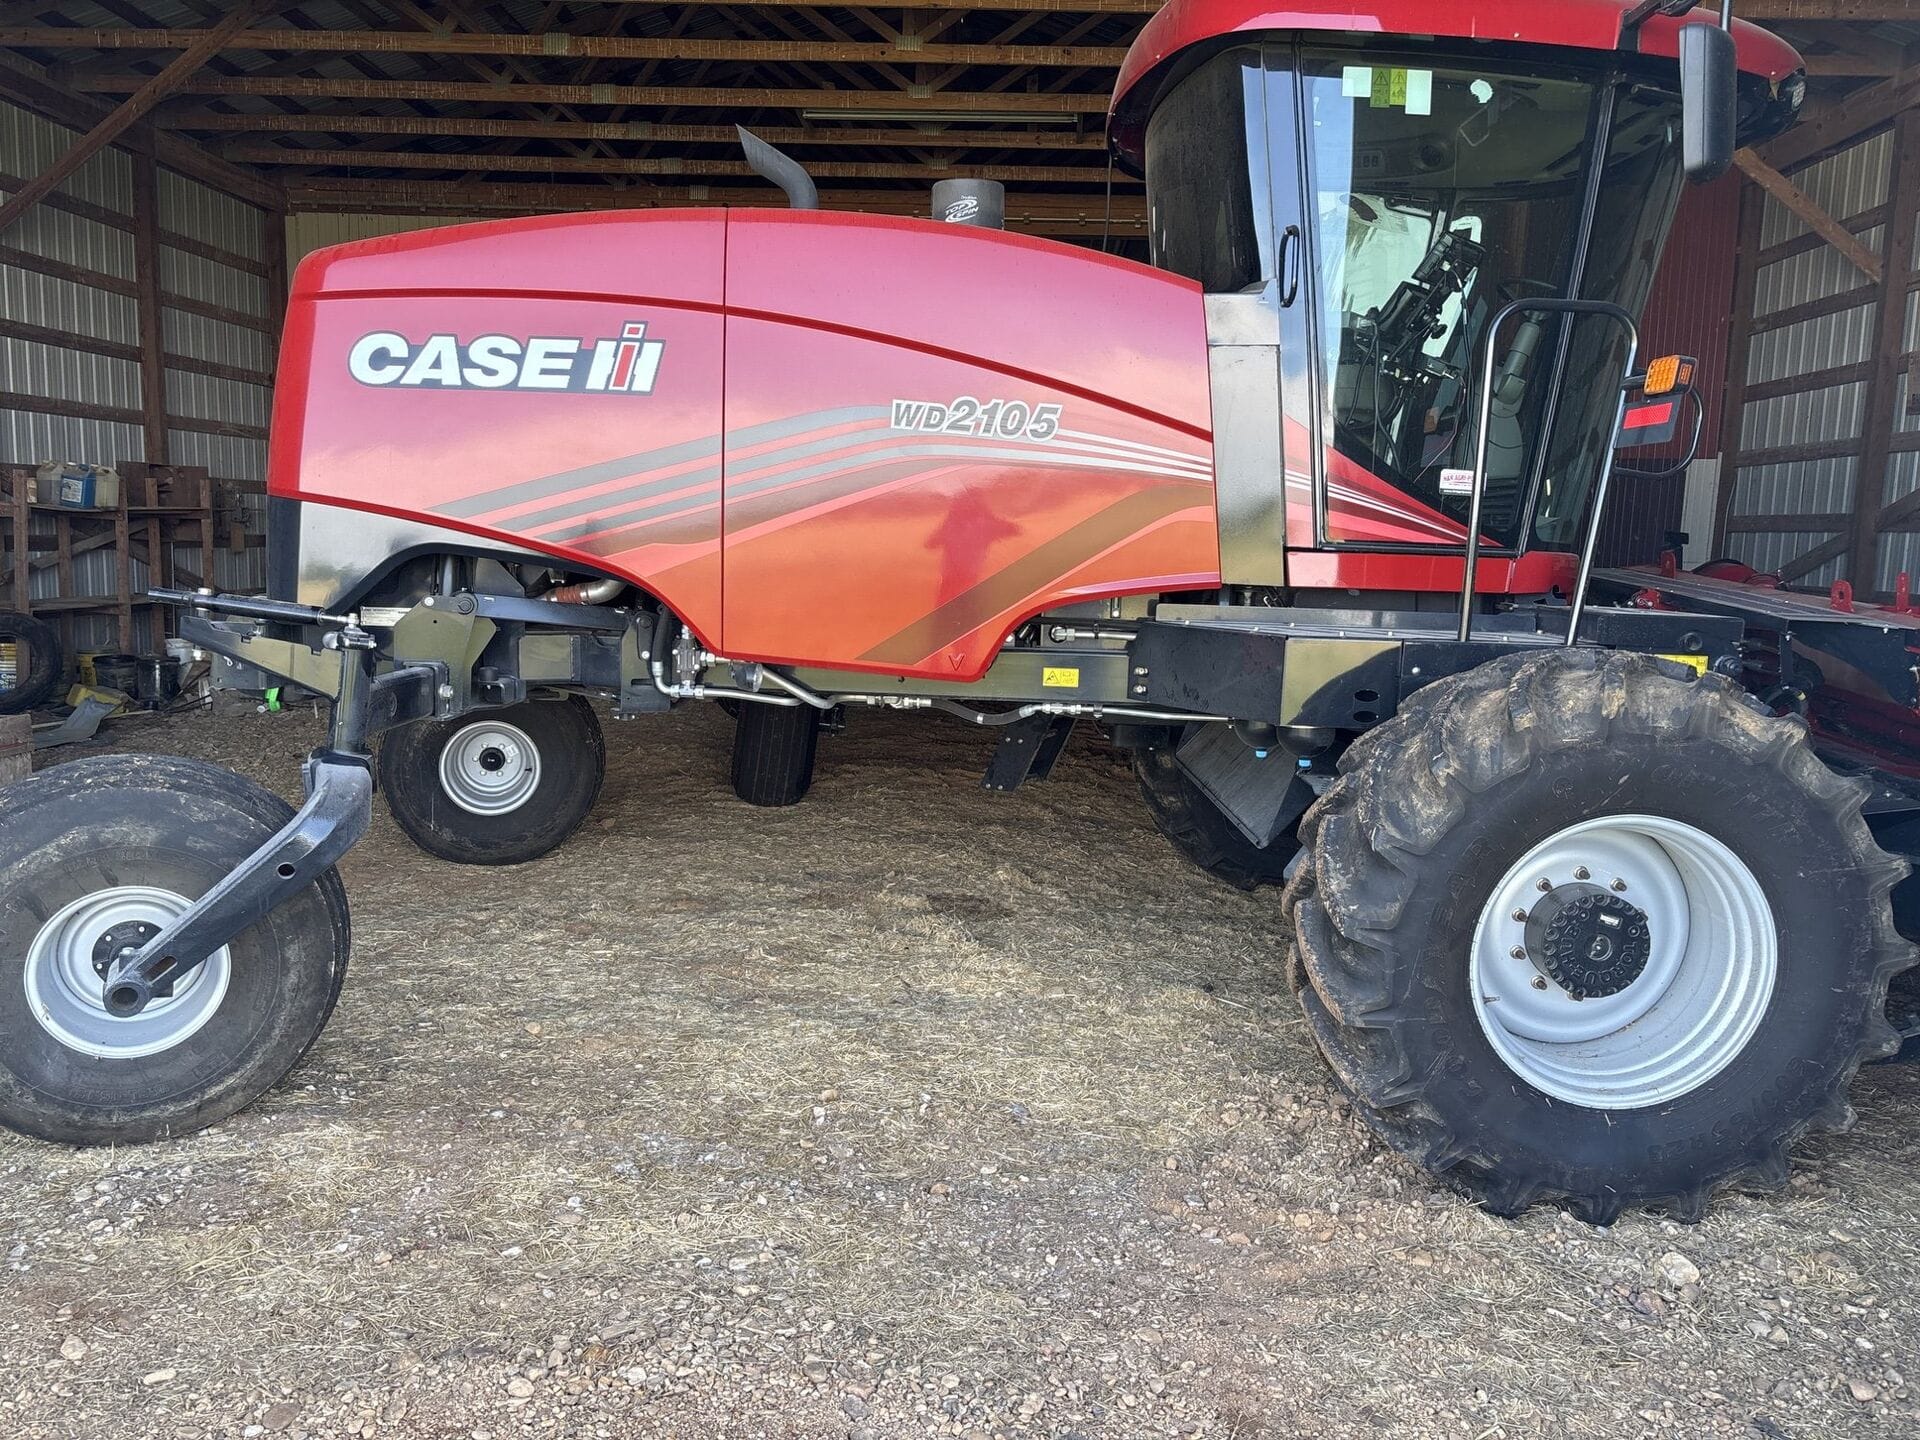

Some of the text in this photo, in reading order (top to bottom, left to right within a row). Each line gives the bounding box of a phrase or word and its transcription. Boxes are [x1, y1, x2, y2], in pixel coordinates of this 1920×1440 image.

[945, 204, 966, 216] TOP
[956, 206, 979, 218] SPIN
[349, 331, 582, 388] CASE
[891, 396, 1063, 442] WD2105
